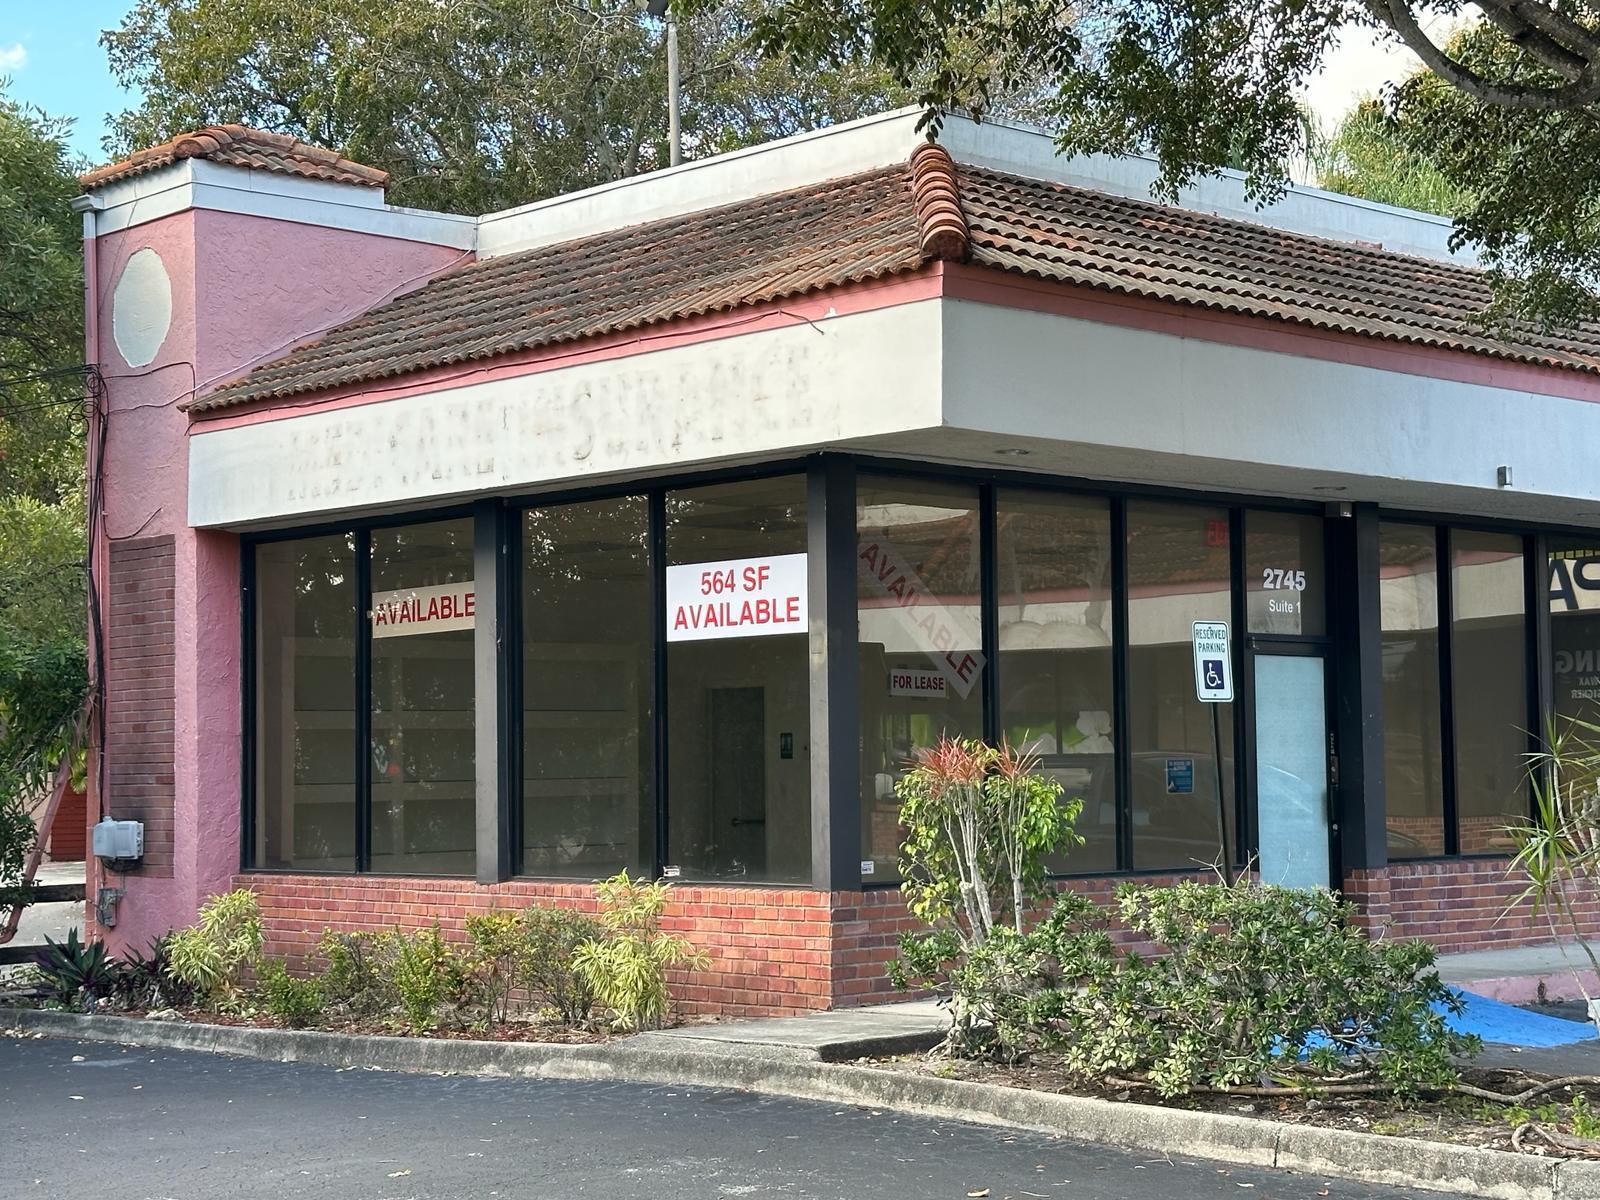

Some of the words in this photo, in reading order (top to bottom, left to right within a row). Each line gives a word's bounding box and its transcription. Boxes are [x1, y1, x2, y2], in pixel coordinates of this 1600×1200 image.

[701, 569, 736, 595] 564
[743, 566, 770, 592] SF
[1263, 568, 1307, 591] 2745
[376, 593, 475, 626] AVAILABLE
[674, 597, 800, 630] AVAILABLE
[860, 543, 977, 684] AVAILABLE
[1268, 599, 1293, 614] Suite
[1296, 601, 1301, 614] 1
[1195, 629, 1226, 640] RESERVED
[1198, 642, 1226, 653] PARKING
[893, 675, 912, 689] FOR
[914, 676, 945, 691] LEASE
